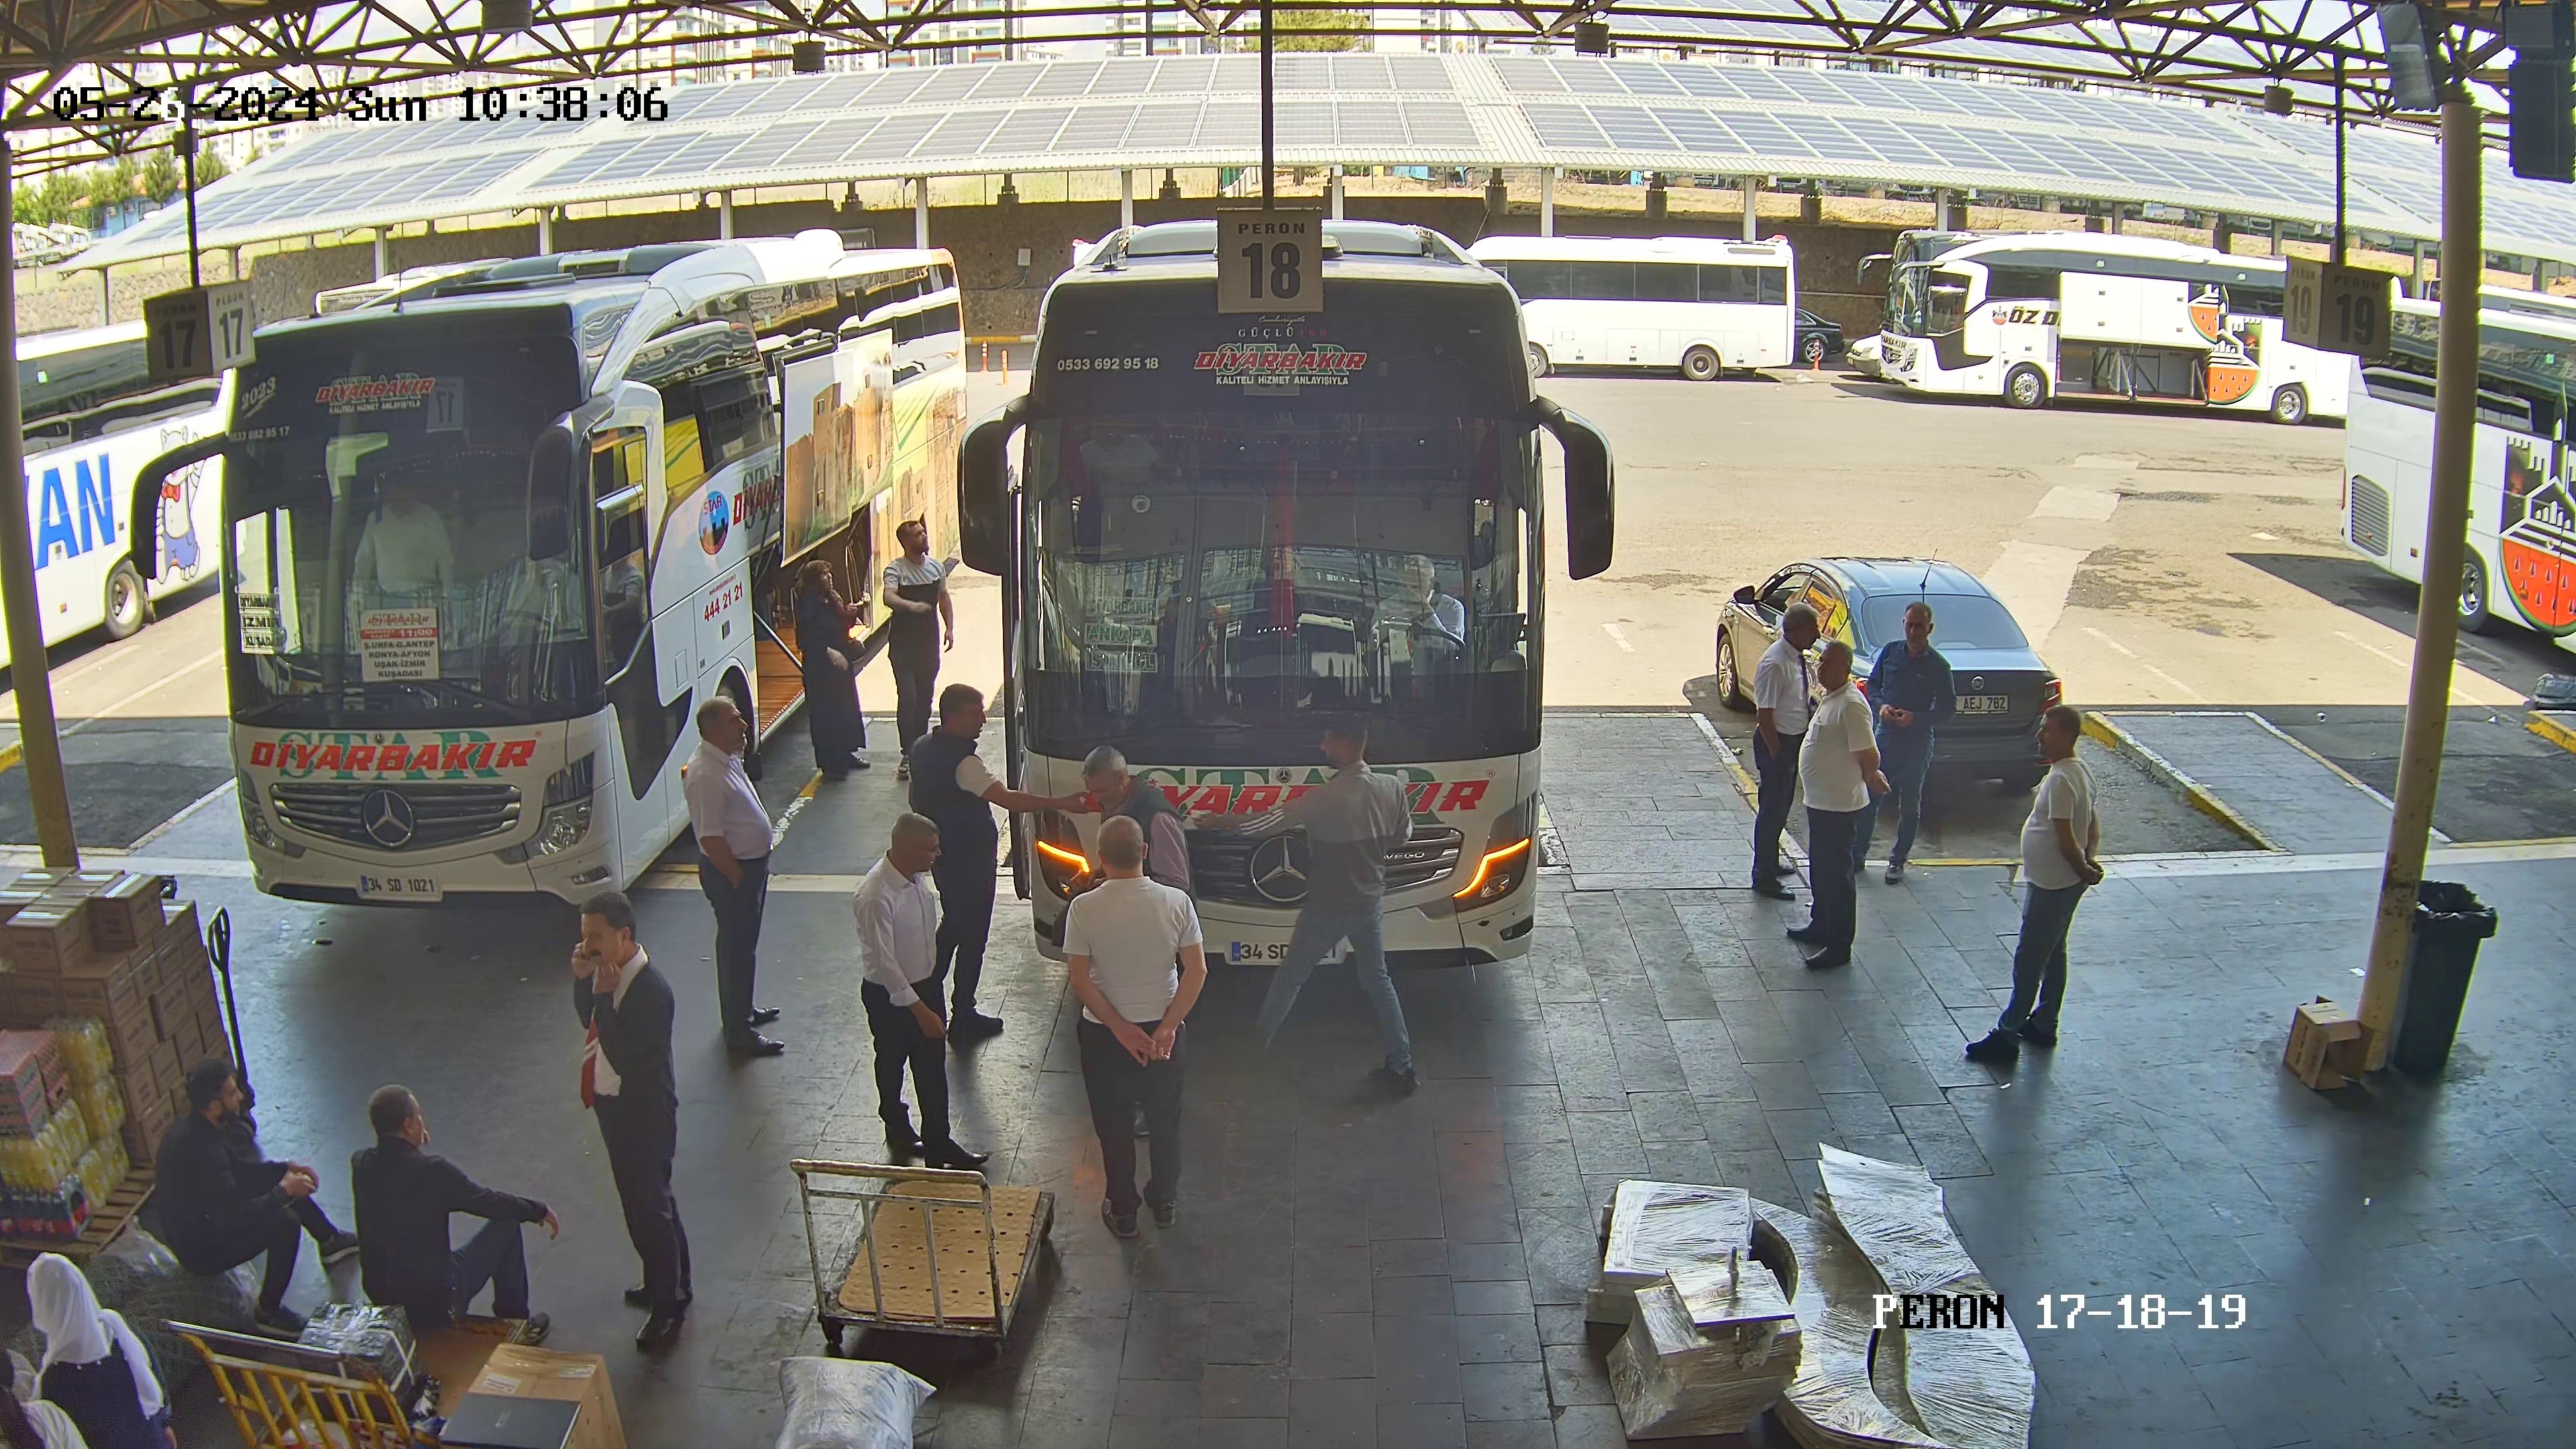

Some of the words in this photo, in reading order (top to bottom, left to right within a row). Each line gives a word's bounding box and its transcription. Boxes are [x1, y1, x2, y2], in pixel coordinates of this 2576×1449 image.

[1238, 223, 1305, 234] PERON
[1242, 242, 1301, 299] 18
[2292, 268, 2315, 280] PERON
[2334, 274, 2380, 290] PERON
[216, 291, 244, 307] PERON
[2009, 306, 2038, 323] ÖZ
[2041, 311, 2060, 327] D
[2291, 285, 2312, 335] 19
[2337, 292, 2375, 345] 19
[159, 319, 195, 368] 17
[219, 308, 243, 358] 17
[1238, 327, 1293, 339] GÜÇLÜ
[1057, 359, 1090, 370] 0533
[1094, 358, 1120, 370] 692
[1124, 358, 1141, 369] 95
[1144, 358, 1159, 369] 18
[1216, 343, 1349, 376] STAR
[241, 376, 276, 411] 2023
[279, 425, 290, 436] 17
[23, 452, 115, 570] AN
[704, 494, 722, 515] STAR
[704, 597, 720, 621] 444
[723, 589, 731, 610] 21
[735, 581, 742, 602] 21
[1964, 697, 1982, 709] AEJ
[1987, 697, 2006, 709] 782
[278, 731, 503, 780] STAR
[368, 877, 382, 891] 34
[387, 878, 401, 892] SD
[408, 878, 434, 892] 1021
[1241, 944, 1263, 959] 34
